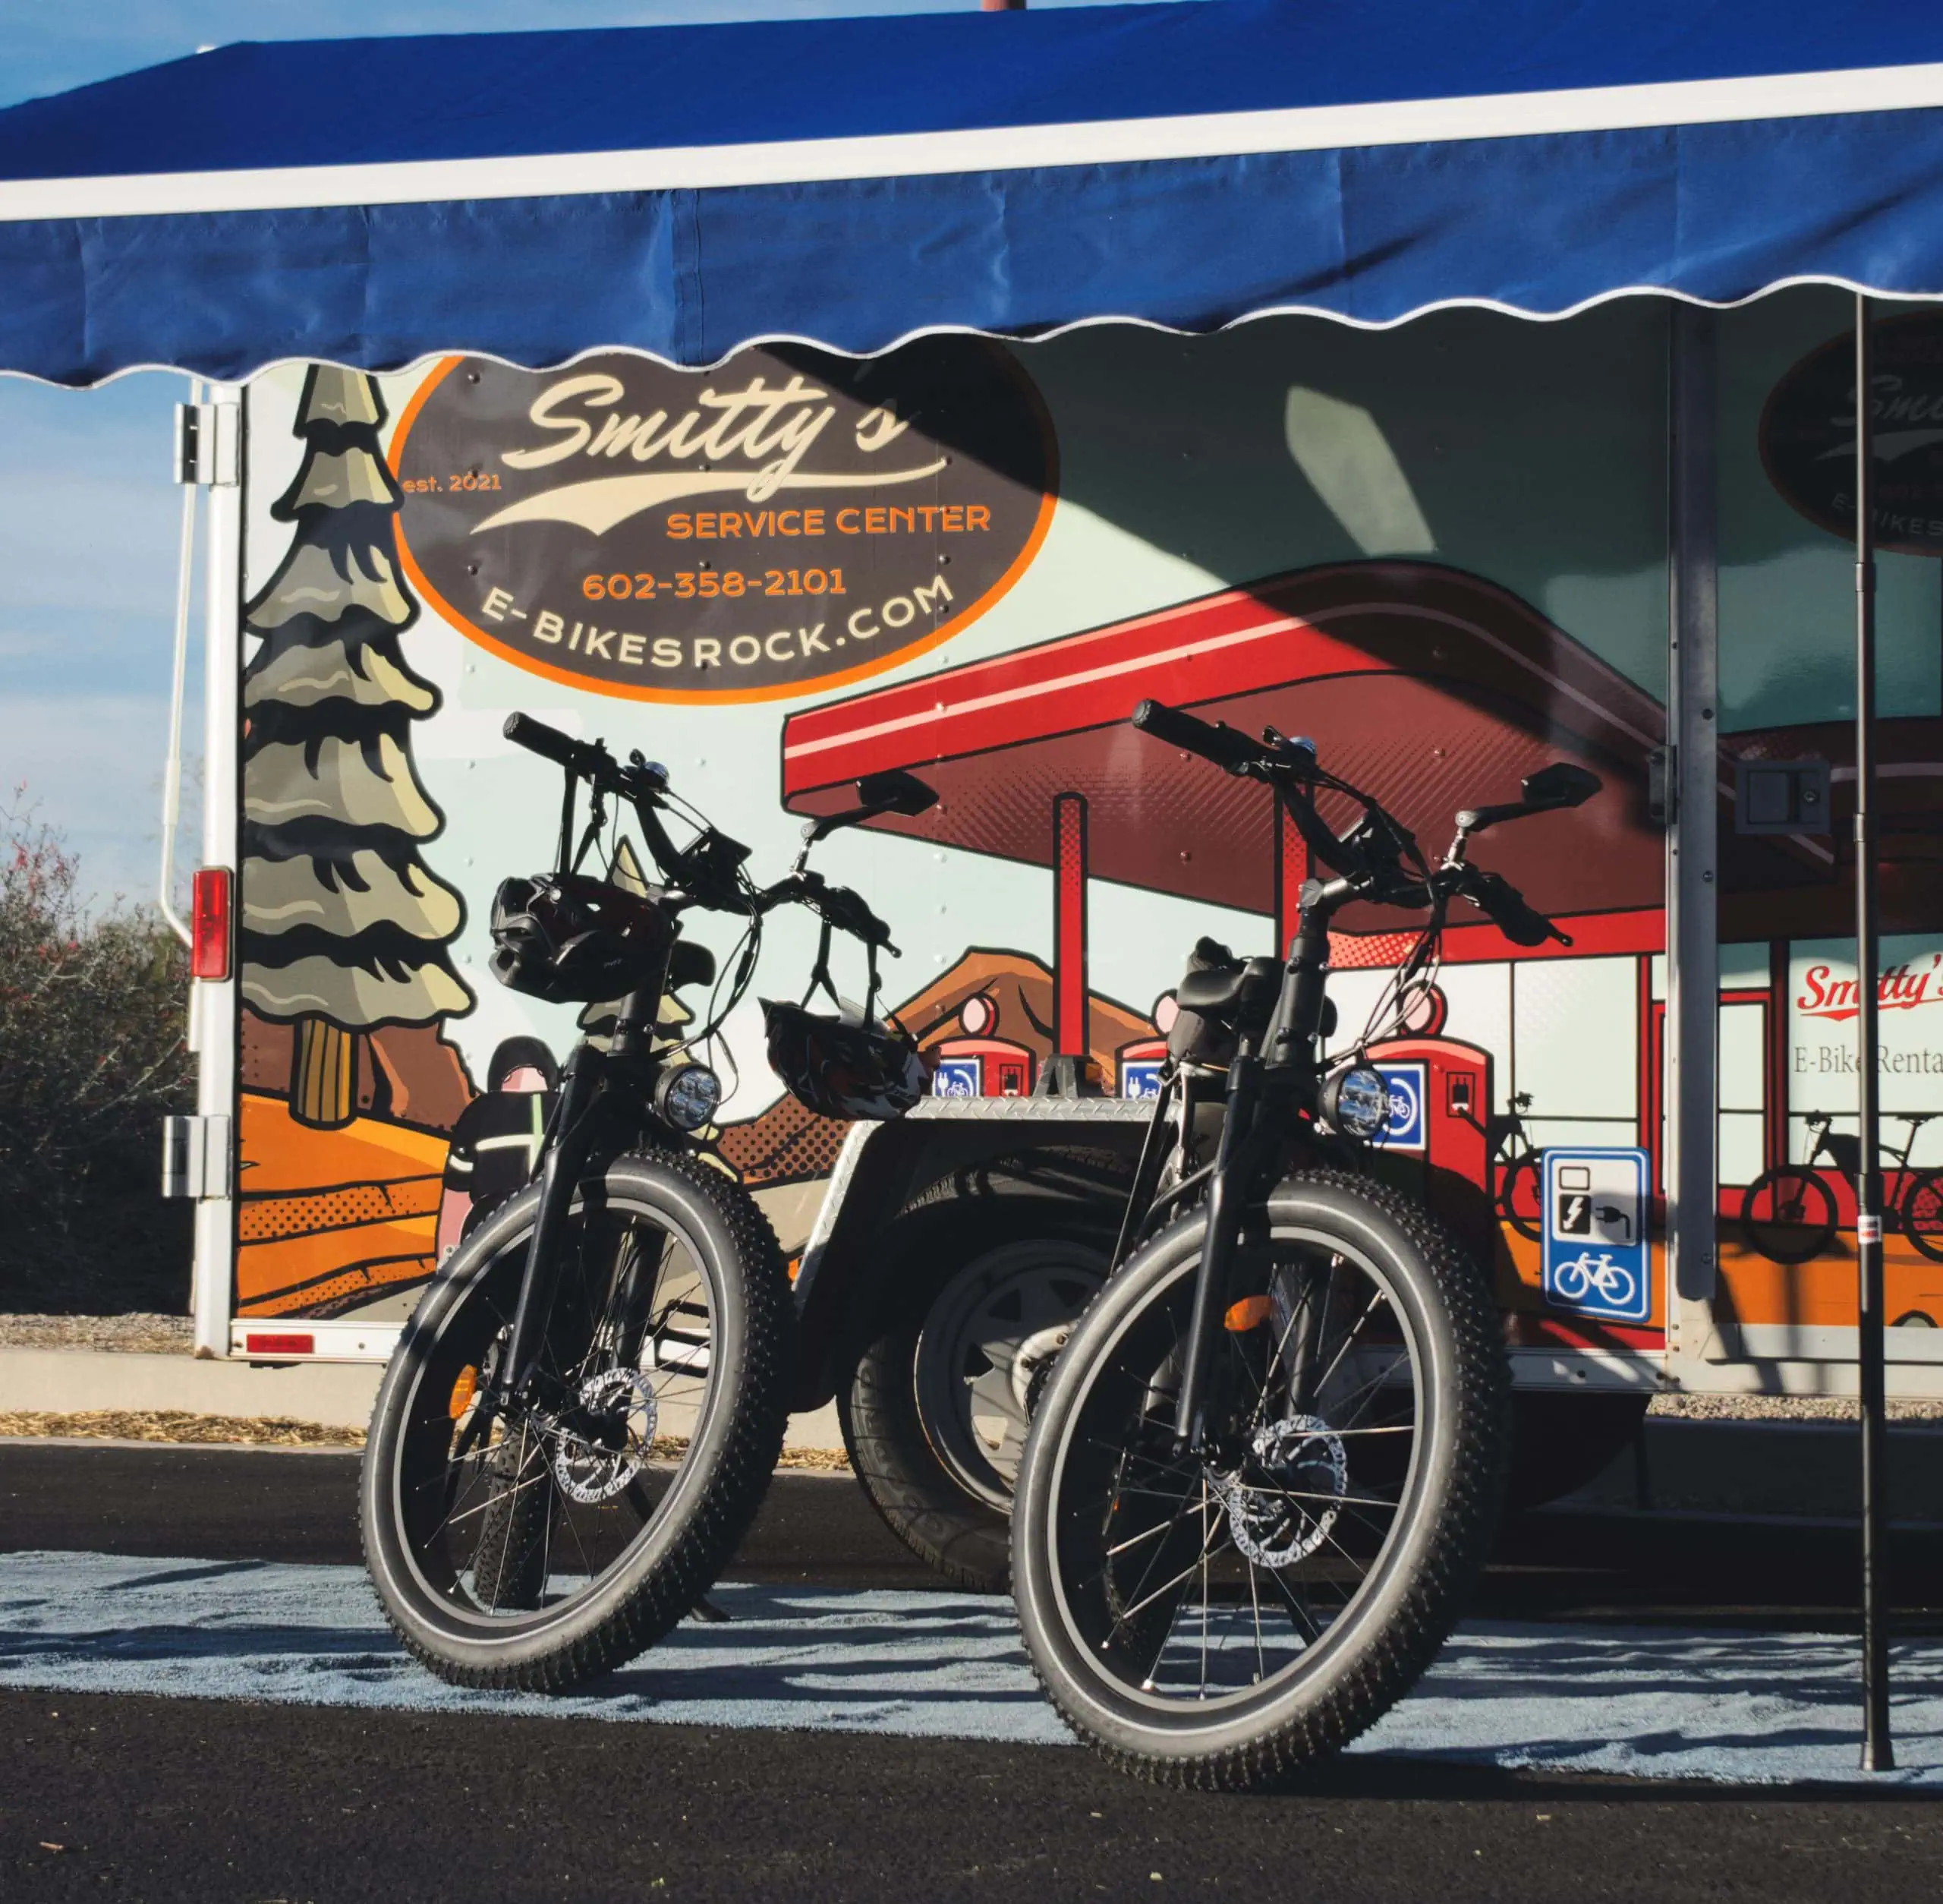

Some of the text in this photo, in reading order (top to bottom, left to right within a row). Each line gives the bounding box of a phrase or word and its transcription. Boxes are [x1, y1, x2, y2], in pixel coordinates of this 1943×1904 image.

[402, 474, 502, 492] est. 2021
[667, 506, 990, 539] SERVICE CENTER
[583, 569, 846, 600] 602-358-2101
[481, 575, 954, 668] E-BIKESROCK.COM
